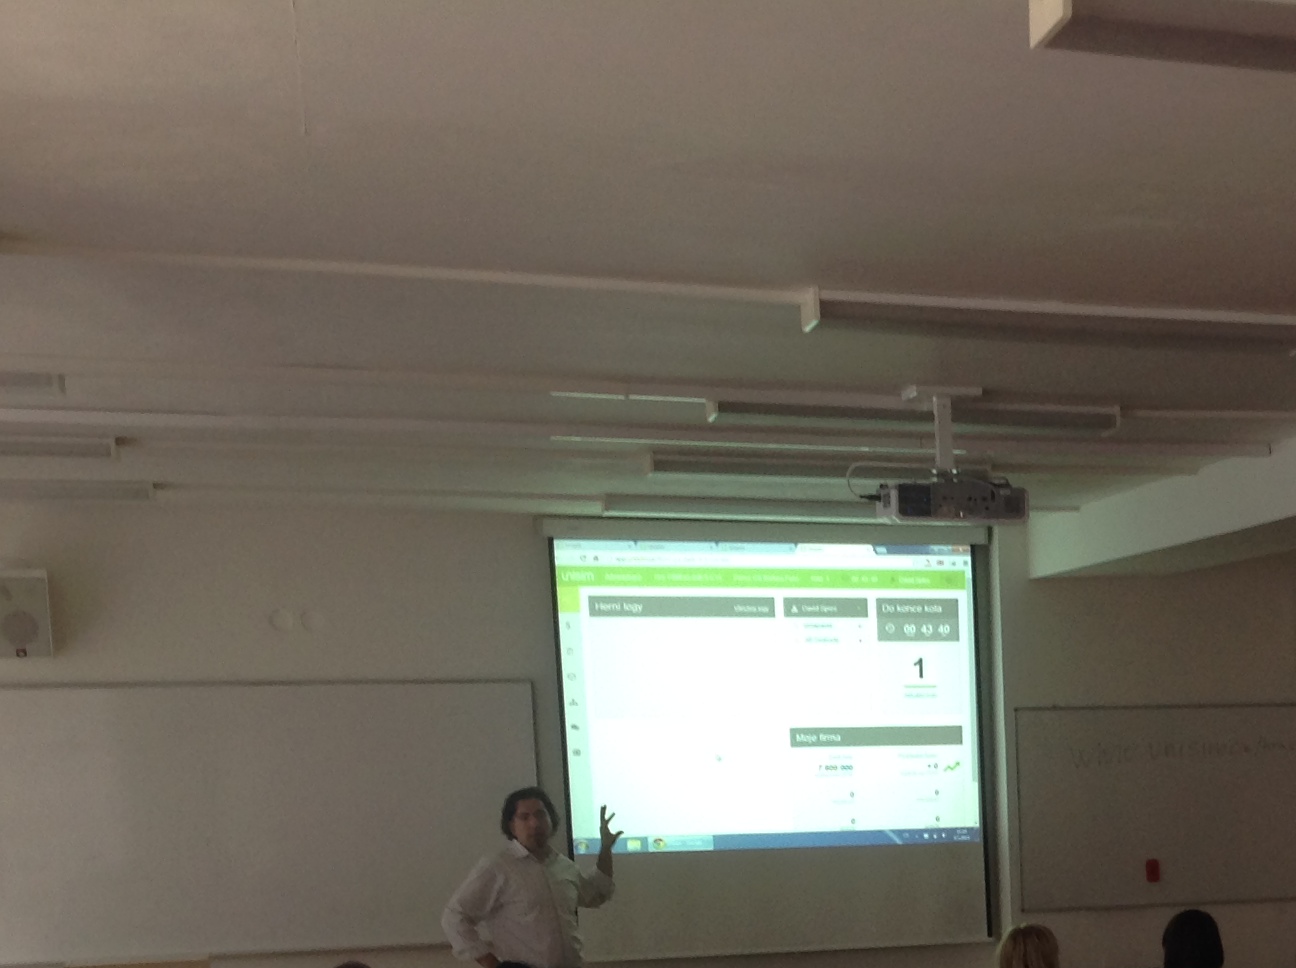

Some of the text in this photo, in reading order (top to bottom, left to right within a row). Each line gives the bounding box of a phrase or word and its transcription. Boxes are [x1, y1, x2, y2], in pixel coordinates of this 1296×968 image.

[881, 604, 895, 613] Do
[920, 623, 933, 634] 43
[937, 624, 950, 634] 40
[913, 657, 923, 679] 1
